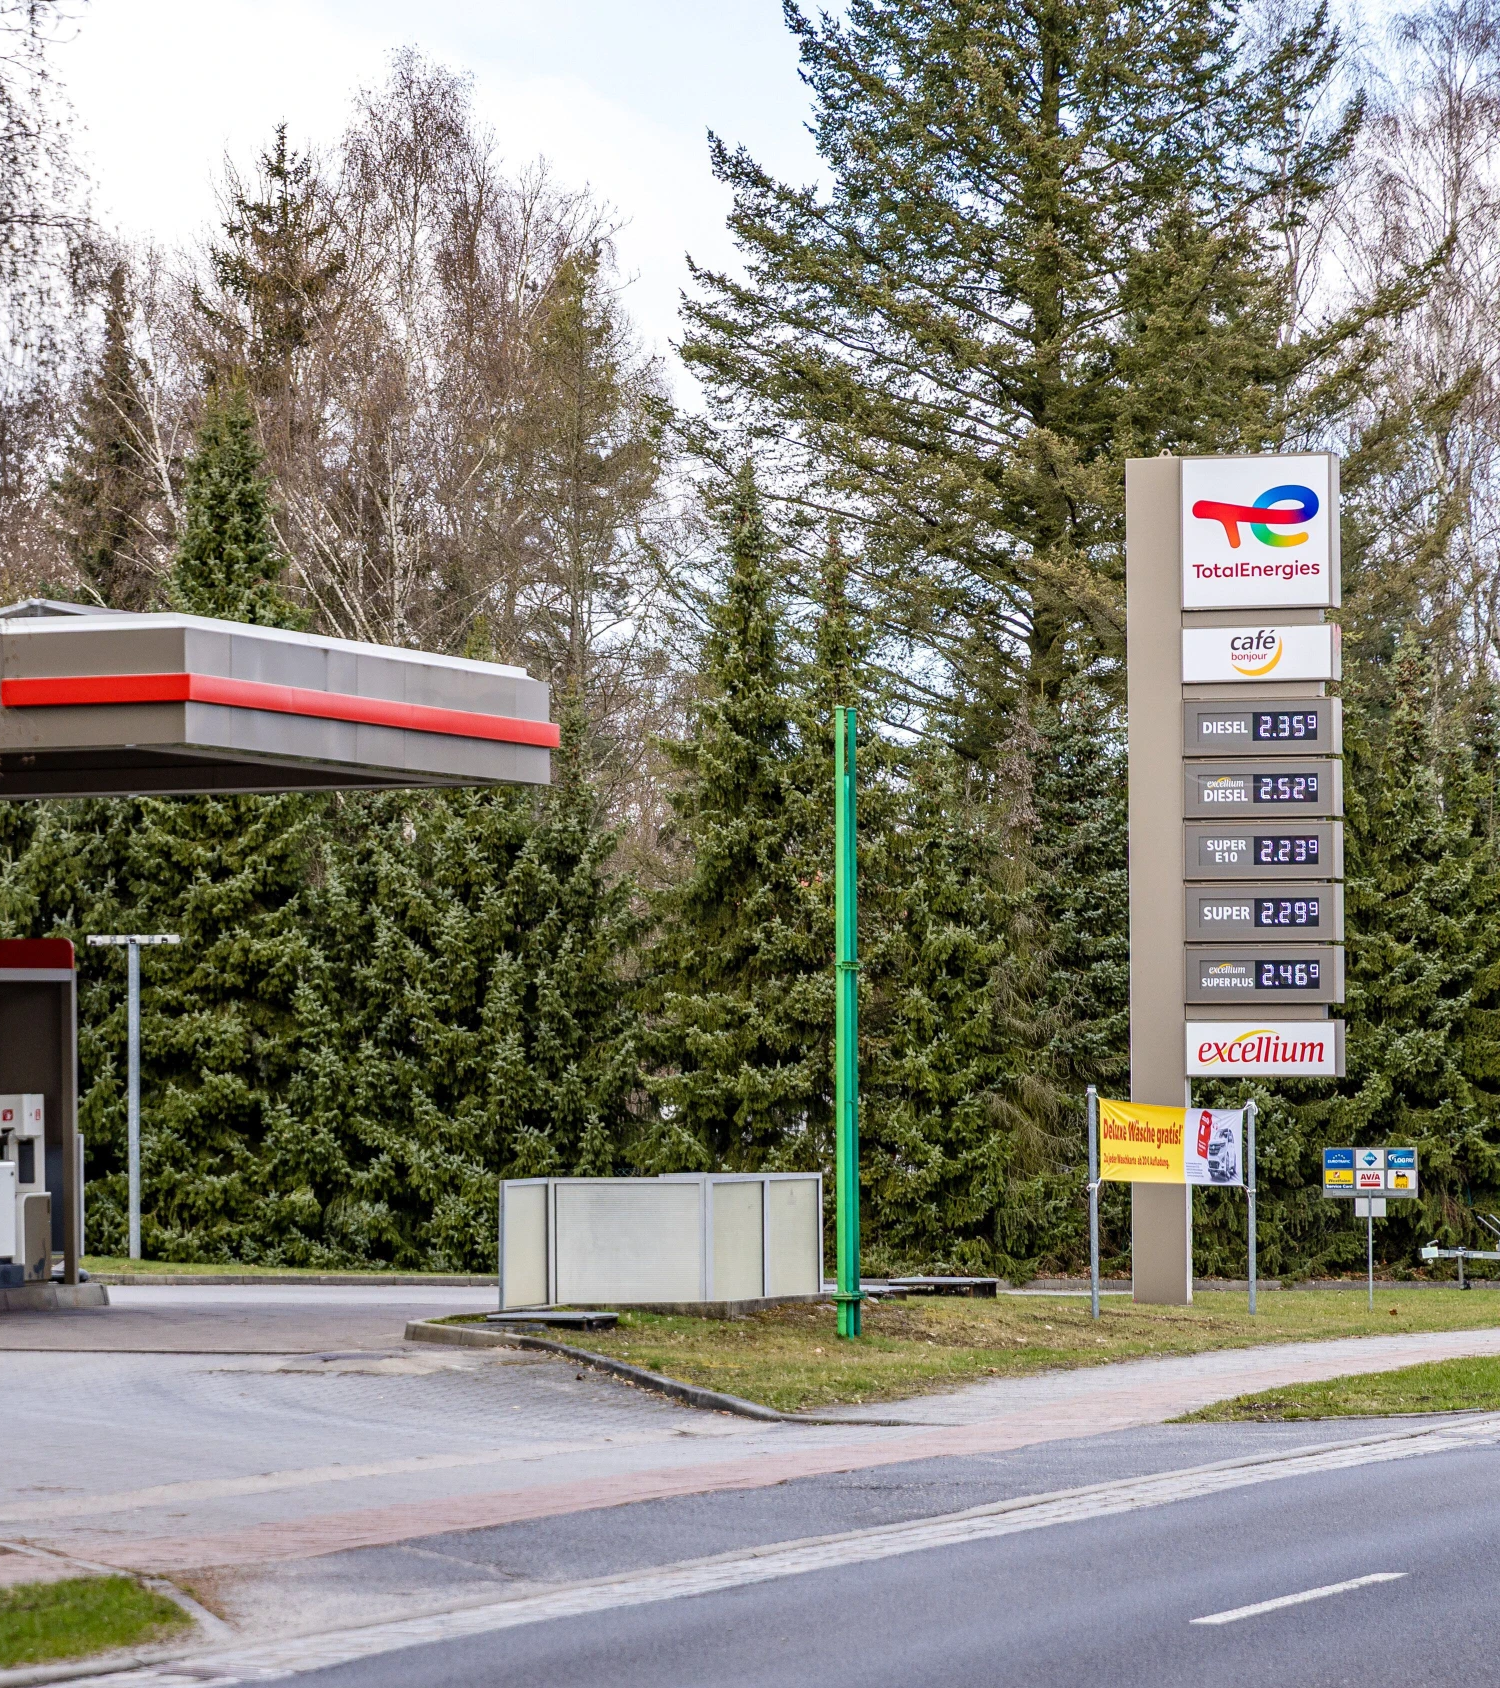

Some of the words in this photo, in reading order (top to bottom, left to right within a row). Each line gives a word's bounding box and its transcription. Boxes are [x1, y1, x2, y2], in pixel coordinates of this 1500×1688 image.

[1193, 560, 1320, 580] TotalEnergies
[1230, 629, 1275, 650] café
[1231, 652, 1268, 662] bonjour
[1202, 721, 1248, 734] DIESEL
[1207, 777, 1244, 788] excellium
[1203, 789, 1248, 802] DIESEL
[1206, 839, 1247, 851] SUPER
[1215, 852, 1238, 863] E10
[1203, 906, 1250, 920] SUPER
[1208, 964, 1246, 974] excellium
[1197, 1035, 1324, 1063] excellium
[1103, 1118, 1127, 1141] Deluxe
[1128, 1120, 1155, 1143] Wäsche
